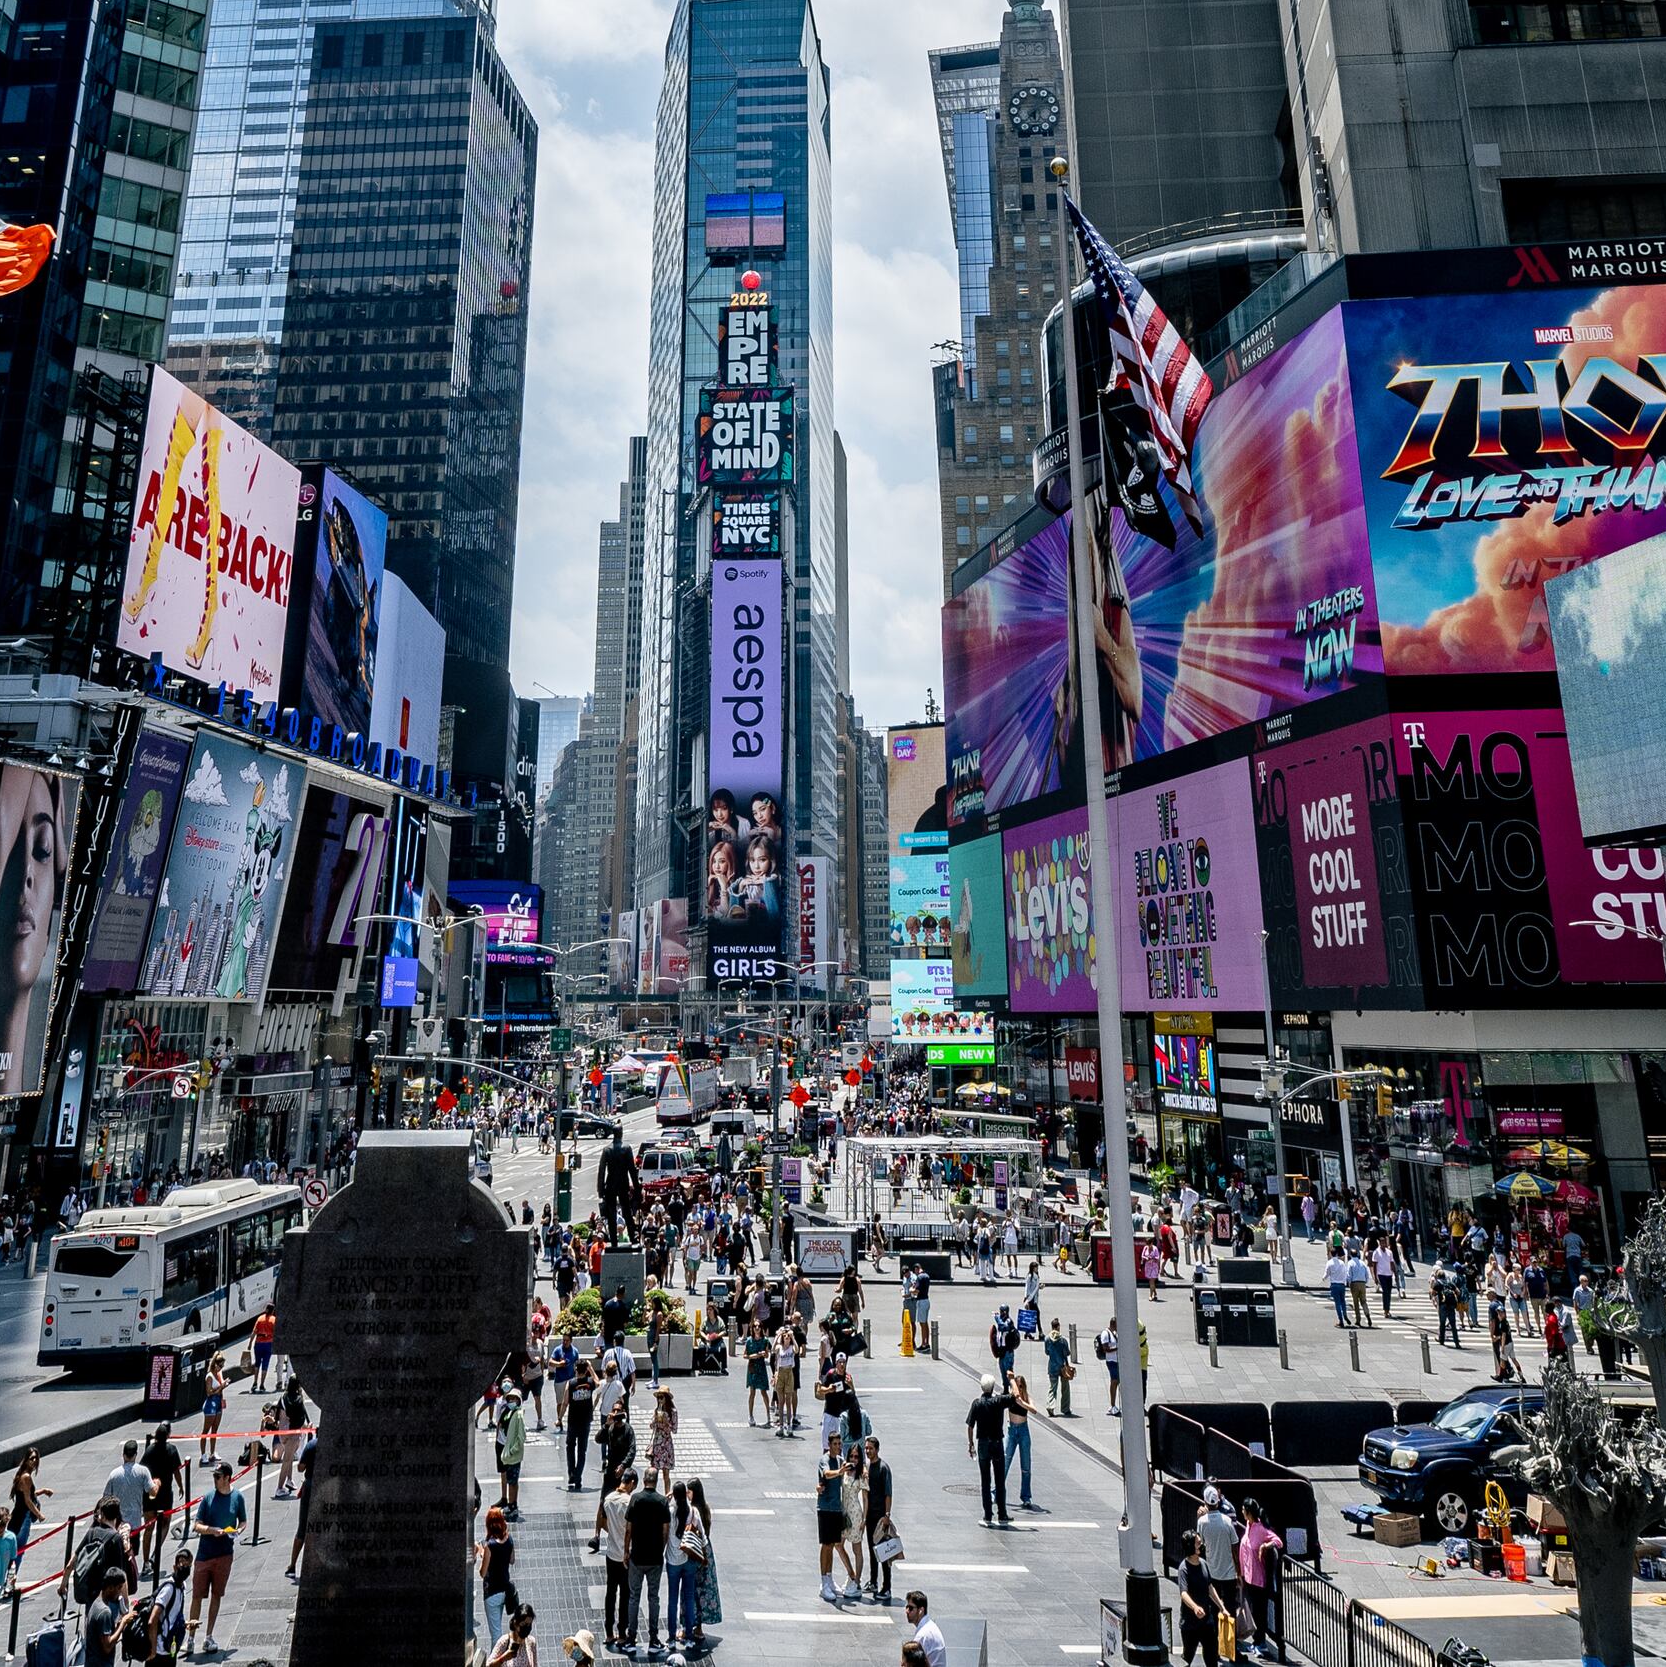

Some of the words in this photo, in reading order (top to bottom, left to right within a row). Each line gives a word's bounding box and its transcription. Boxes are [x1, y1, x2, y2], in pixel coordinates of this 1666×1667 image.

[730, 292, 768, 306] 2022
[1241, 316, 1278, 354] MARRIOTT
[1535, 327, 1573, 343] MARVEL
[1574, 325, 1613, 342] STUDIOS
[1241, 337, 1275, 370] MARQUIS
[712, 421, 750, 446] OF
[712, 432, 780, 469] MIND
[1390, 471, 1522, 529] LOVE
[1517, 478, 1560, 498] AND
[297, 509, 312, 521] LG
[723, 503, 770, 515] TIMES
[722, 516, 770, 528] SQUARE
[722, 526, 770, 544] NYC
[217, 512, 293, 607] BACK!
[740, 570, 768, 578] Spotify
[1295, 608, 1307, 633] IN
[1308, 586, 1364, 625] THEATERS
[1303, 618, 1356, 692] NOW
[722, 604, 764, 758] aespa
[1266, 714, 1292, 731] MARRIOTT
[1267, 728, 1291, 743] MARQUIS
[1301, 793, 1356, 843] MORE
[496, 810, 506, 853] 1500
[1309, 848, 1360, 895] COOL
[898, 887, 920, 897] Coupon
[1311, 901, 1368, 949] STUFF
[714, 945, 727, 953] THE
[730, 945, 747, 953] NEW
[749, 945, 776, 953] ALBUM
[714, 959, 776, 976] GIRLS
[1283, 1013, 1309, 1025] SEPHORA
[959, 1048, 981, 1060] NEW
[985, 1123, 1023, 1133] DISCOVER
[93, 1236, 111, 1245] 4270
[822, 1239, 842, 1247] GOLD
[413, 1257, 470, 1271] COLONEL
[329, 1276, 399, 1294] FRANCIS
[421, 1276, 482, 1294] DUFFY
[344, 1321, 406, 1335] CATHOLIC
[412, 1321, 457, 1335] PRIEST
[369, 1355, 428, 1370] CHAPLAIN
[350, 1434, 373, 1447] LIFE
[378, 1434, 396, 1447] OF
[401, 1434, 451, 1447] SERVICE
[329, 1464, 357, 1477] GOD
[361, 1464, 389, 1477] AND
[394, 1464, 452, 1477] COUNTRY
